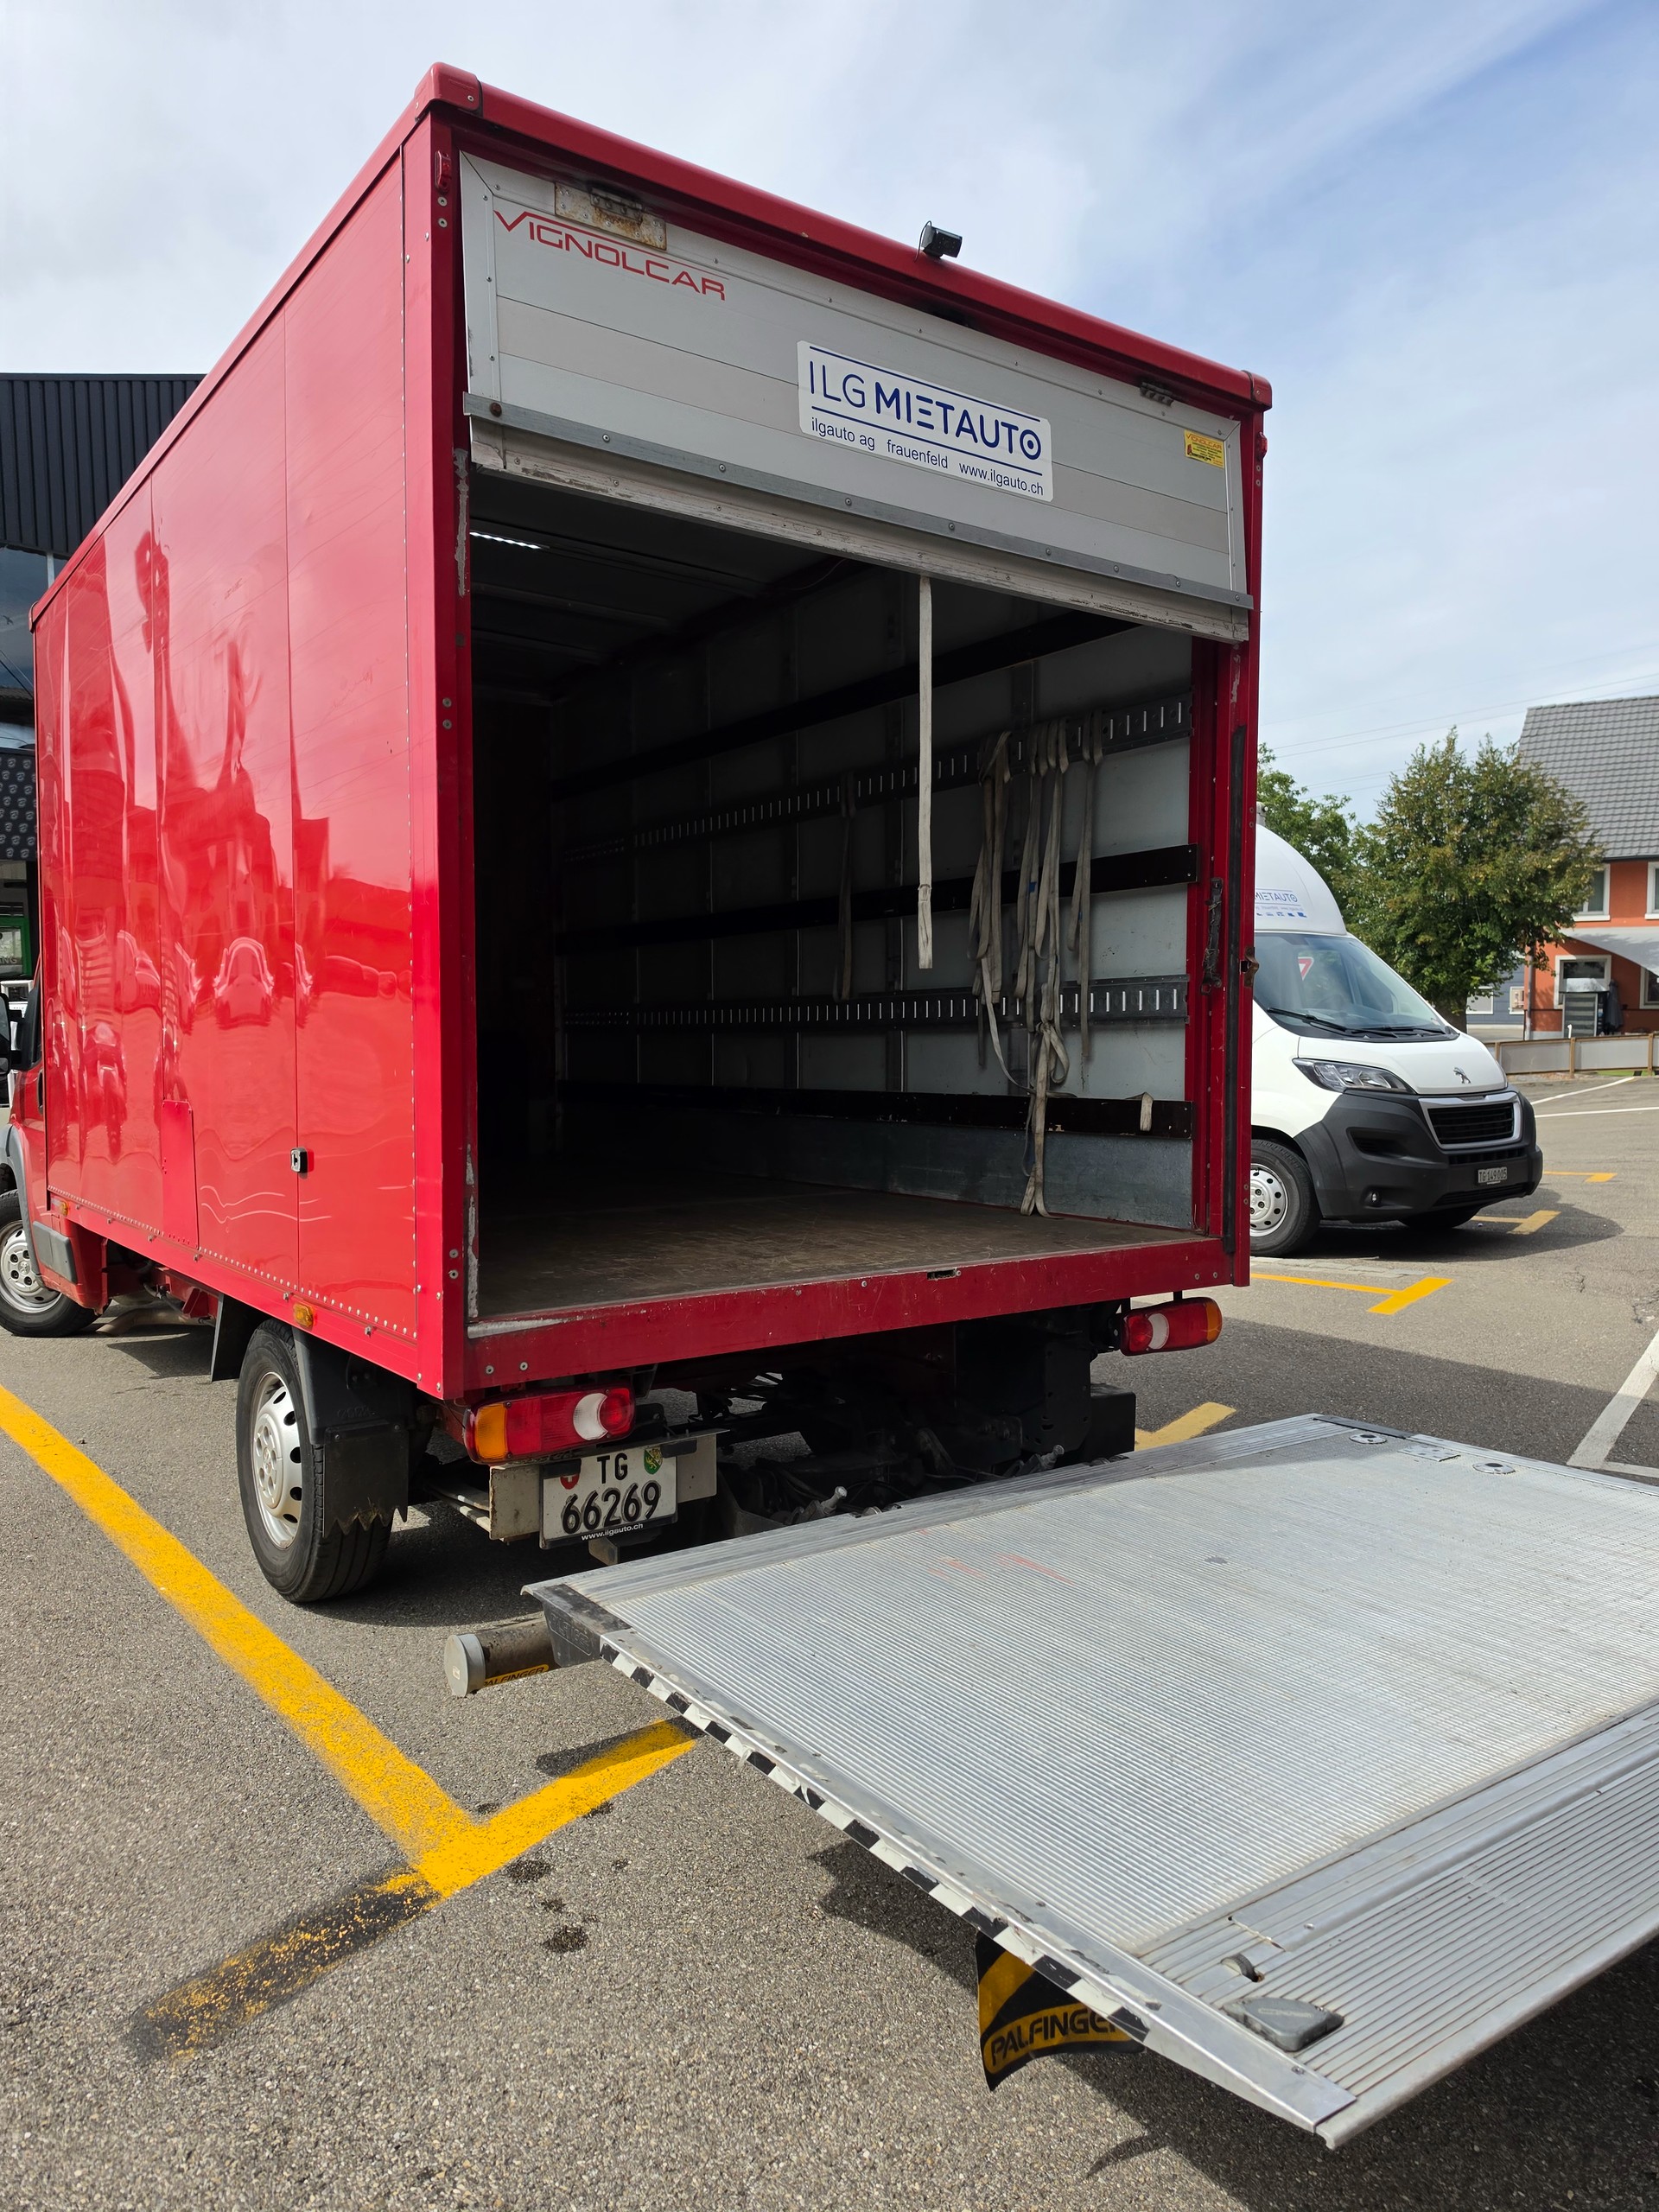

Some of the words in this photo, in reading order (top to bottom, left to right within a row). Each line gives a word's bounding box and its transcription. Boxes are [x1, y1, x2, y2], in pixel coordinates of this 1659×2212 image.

[494, 210, 729, 301] VIGNOLCAR
[810, 360, 865, 408] ILG
[875, 381, 1041, 460] MIETAUTO
[811, 416, 855, 443] ilgauto
[859, 433, 875, 451] ag
[887, 439, 948, 469] frauenfeld
[959, 462, 1044, 496] www.ilgauto.ch
[597, 1452, 628, 1484] TG
[562, 1480, 661, 1534] 66269
[582, 1522, 644, 1541] www.ilgauto.ch
